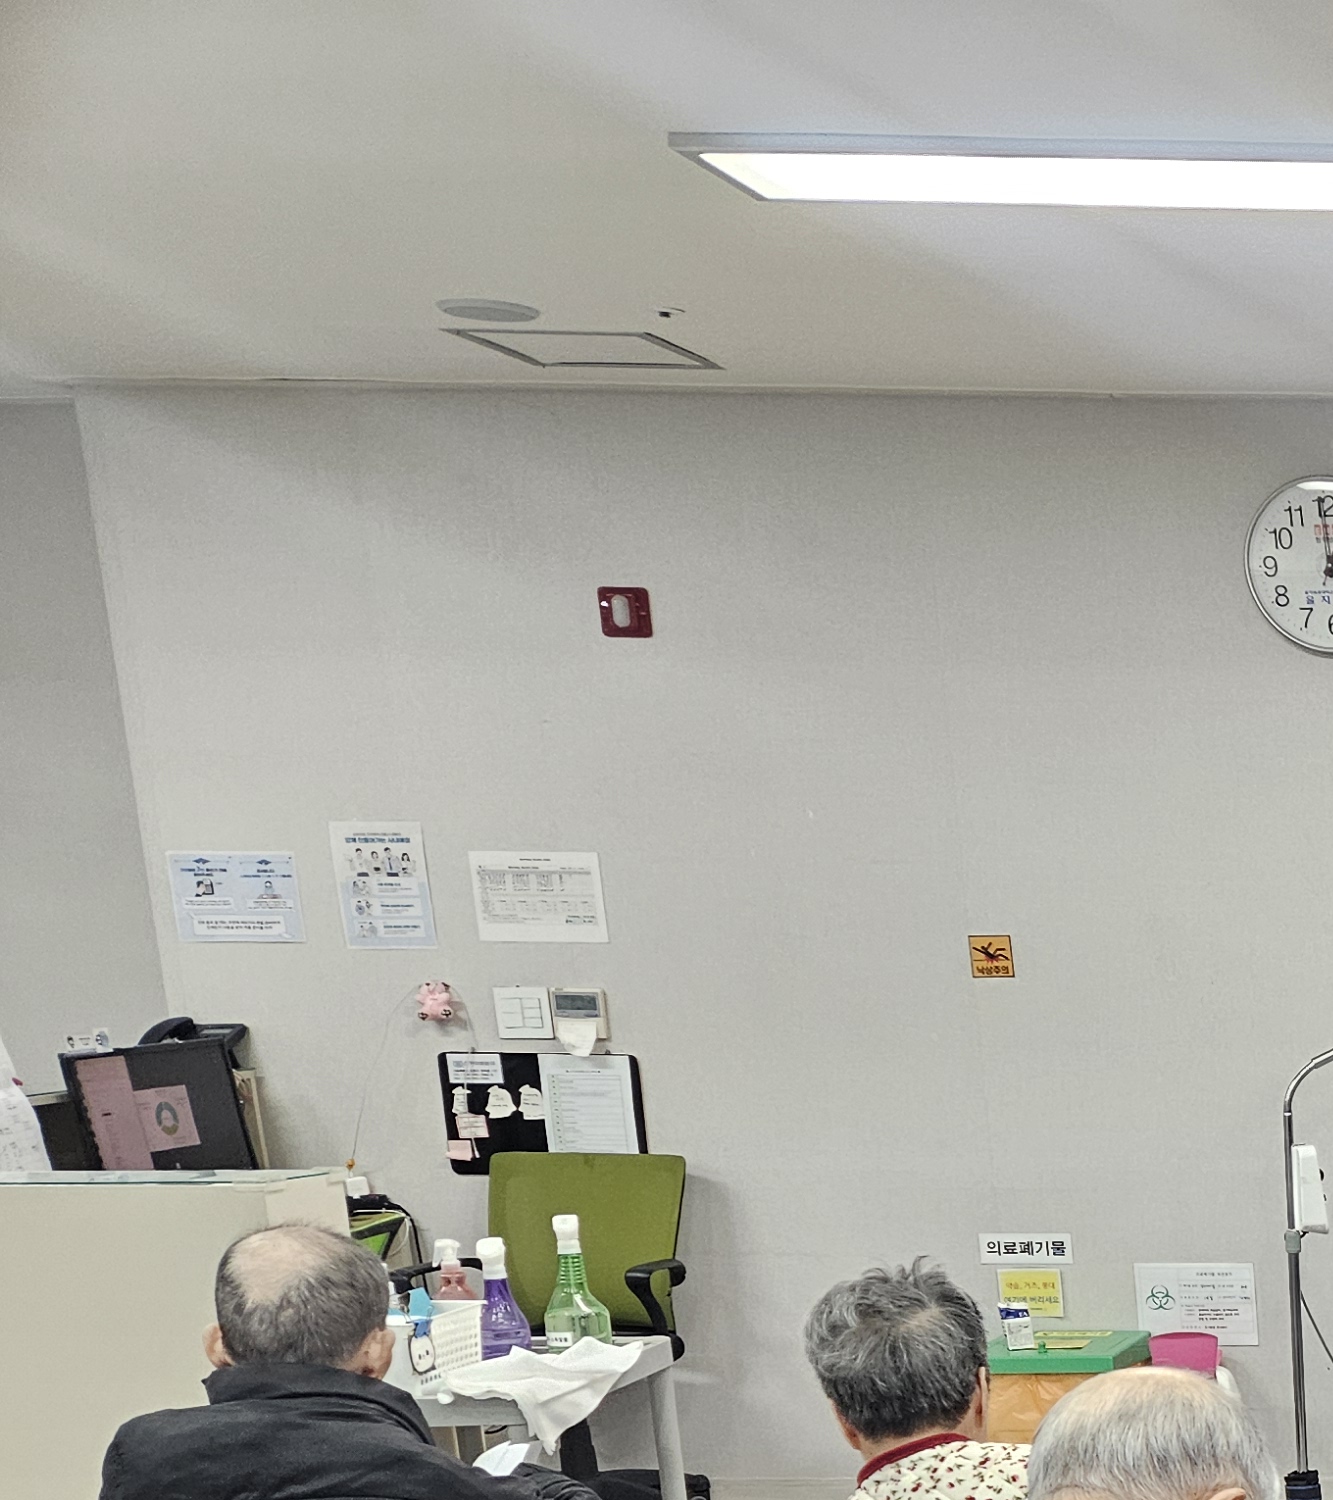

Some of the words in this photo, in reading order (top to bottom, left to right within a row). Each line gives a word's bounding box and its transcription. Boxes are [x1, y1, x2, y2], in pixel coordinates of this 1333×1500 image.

[1284, 505, 1304, 527] 11
[1268, 526, 1293, 549] 10
[1263, 556, 1278, 577] 9
[1274, 585, 1290, 607] 8
[1299, 607, 1314, 628] 7
[986, 1240, 1067, 1257] 의료폐기물
